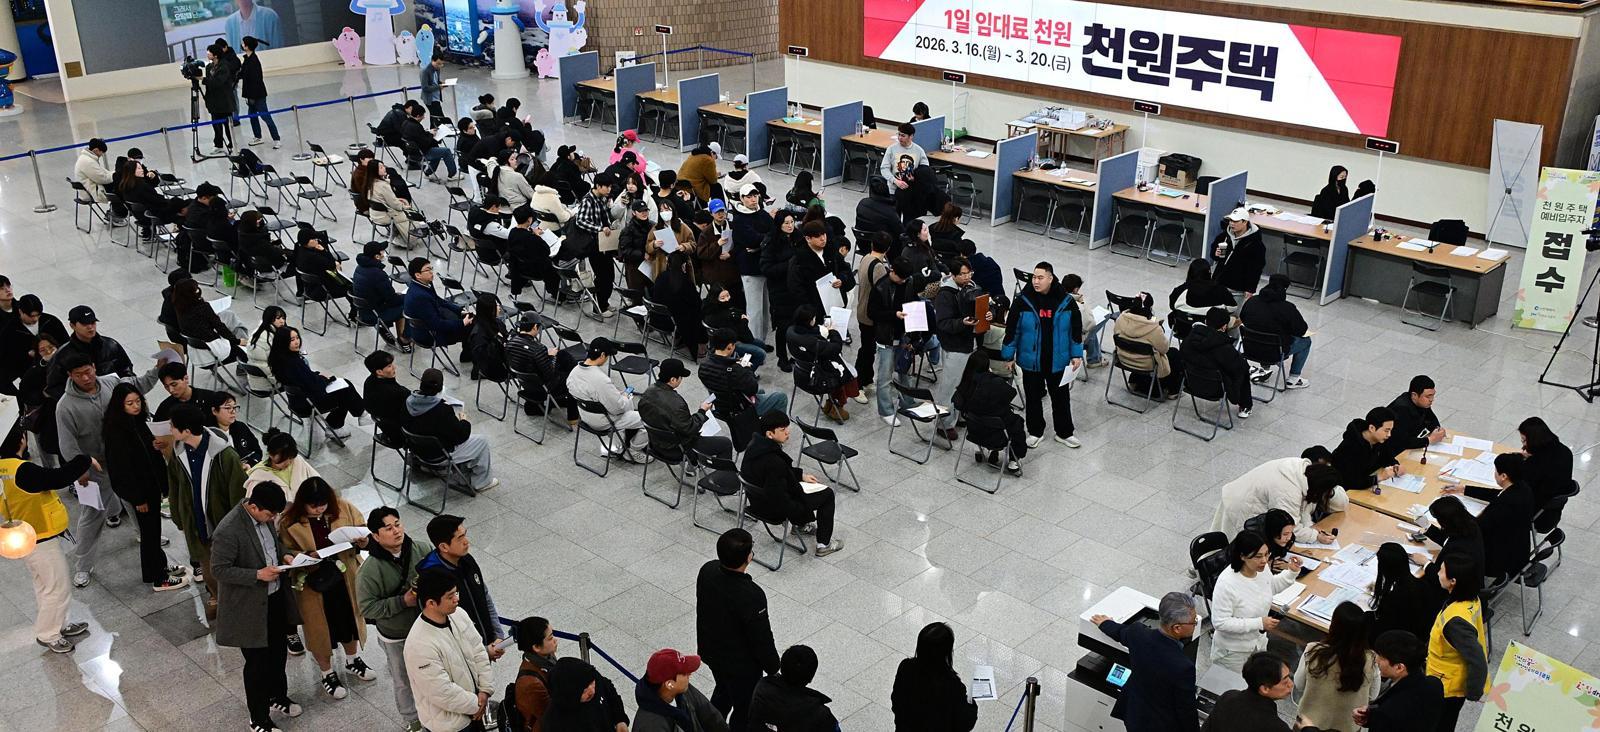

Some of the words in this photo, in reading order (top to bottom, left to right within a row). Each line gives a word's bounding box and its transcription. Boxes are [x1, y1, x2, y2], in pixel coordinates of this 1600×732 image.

[944, 8, 970, 34] 1일
[975, 12, 1029, 40] 임대료
[1034, 18, 1072, 48] 천원
[915, 35, 949, 53] 2026.
[951, 41, 963, 55] 3.
[965, 42, 1001, 63] 16.(월)
[1015, 49, 1027, 64] 3.
[1030, 51, 1072, 74] 20.(금)
[1081, 22, 1279, 103] 천원주택
[1540, 211, 1586, 225] 예비입주자
